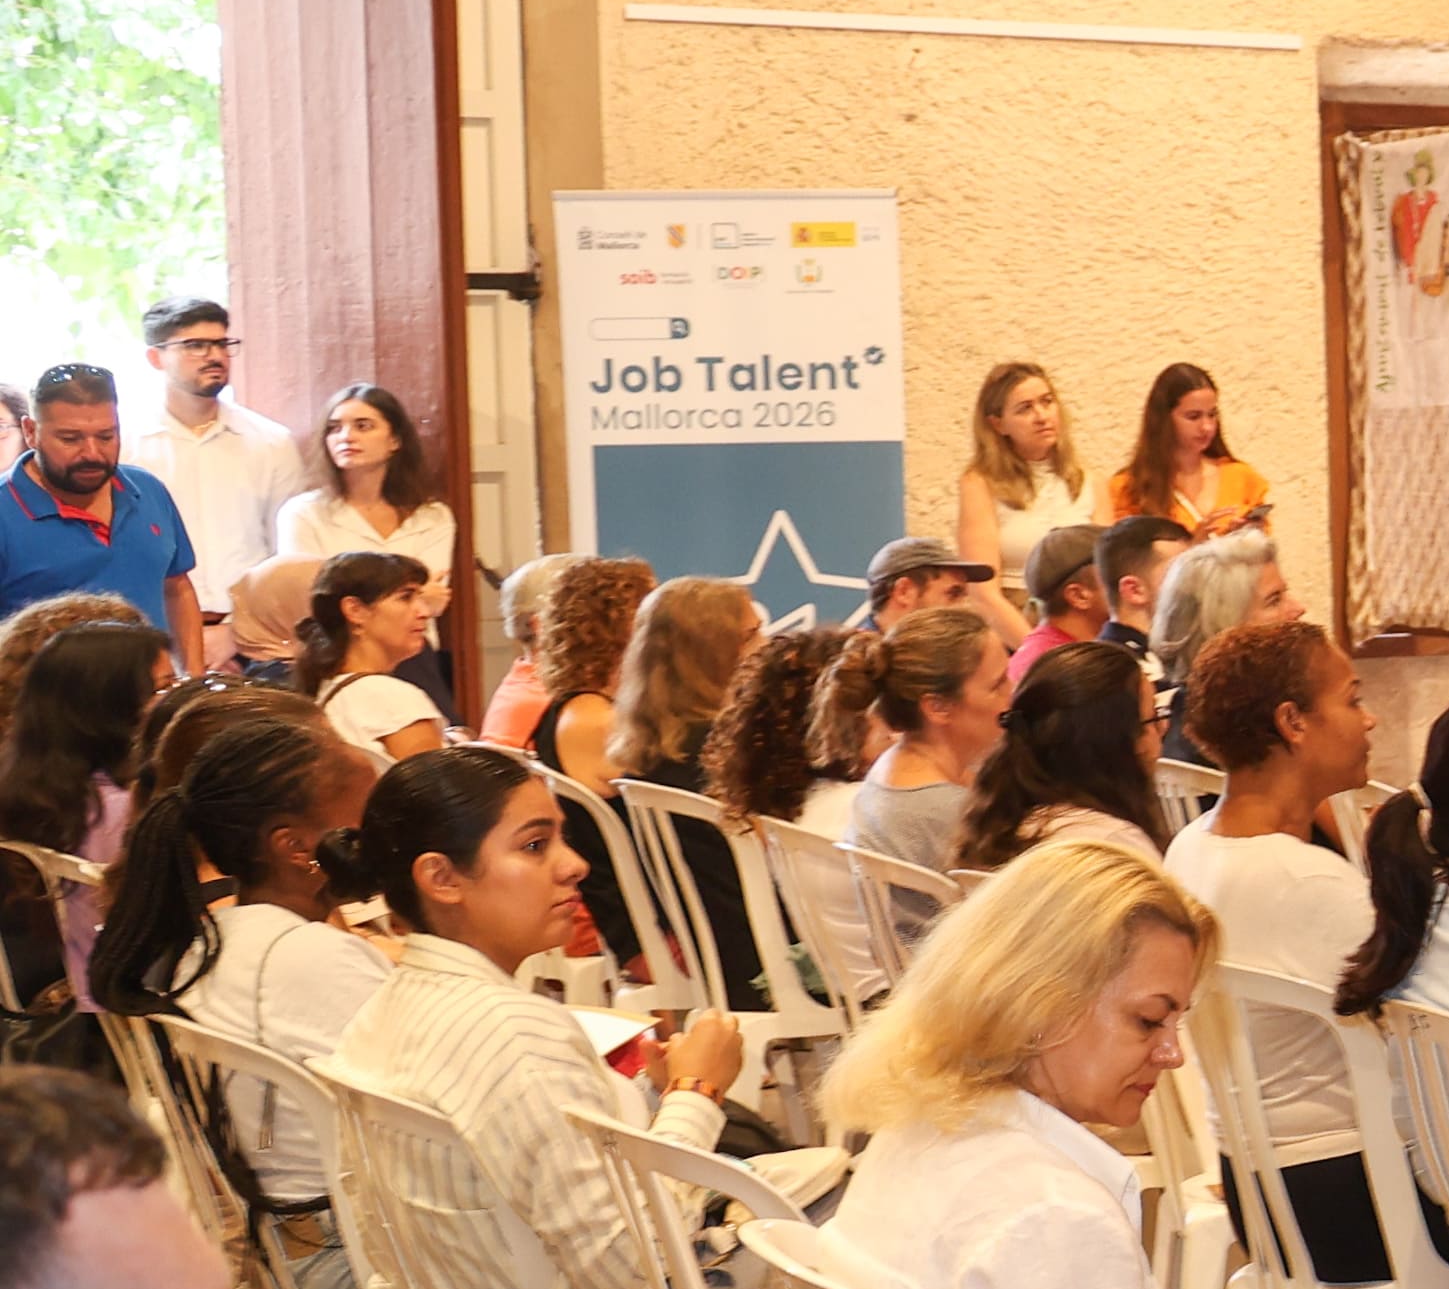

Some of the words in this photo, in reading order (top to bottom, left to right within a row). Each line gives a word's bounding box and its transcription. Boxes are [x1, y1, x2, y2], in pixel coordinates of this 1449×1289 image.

[589, 356, 683, 394] Job
[694, 355, 860, 392] Talent
[590, 402, 743, 431] Mallorca
[753, 400, 837, 429] 2026
